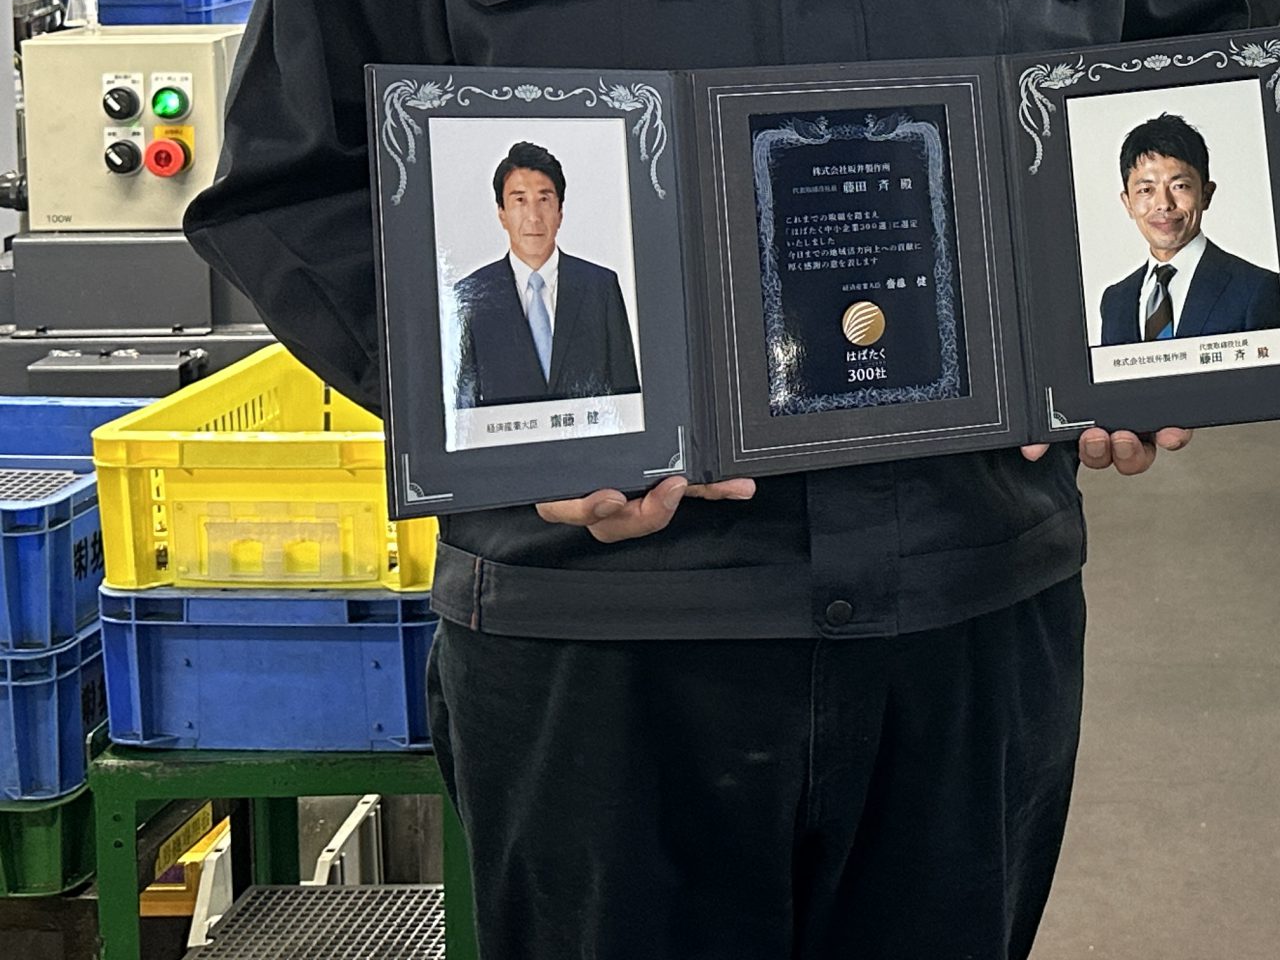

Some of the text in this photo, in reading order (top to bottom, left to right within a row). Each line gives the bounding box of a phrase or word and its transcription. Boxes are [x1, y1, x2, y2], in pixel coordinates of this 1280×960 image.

[46, 214, 73, 224] 100W
[786, 237, 836, 248] いたしました
[846, 348, 887, 362] はばたく
[847, 367, 888, 382] 300社
